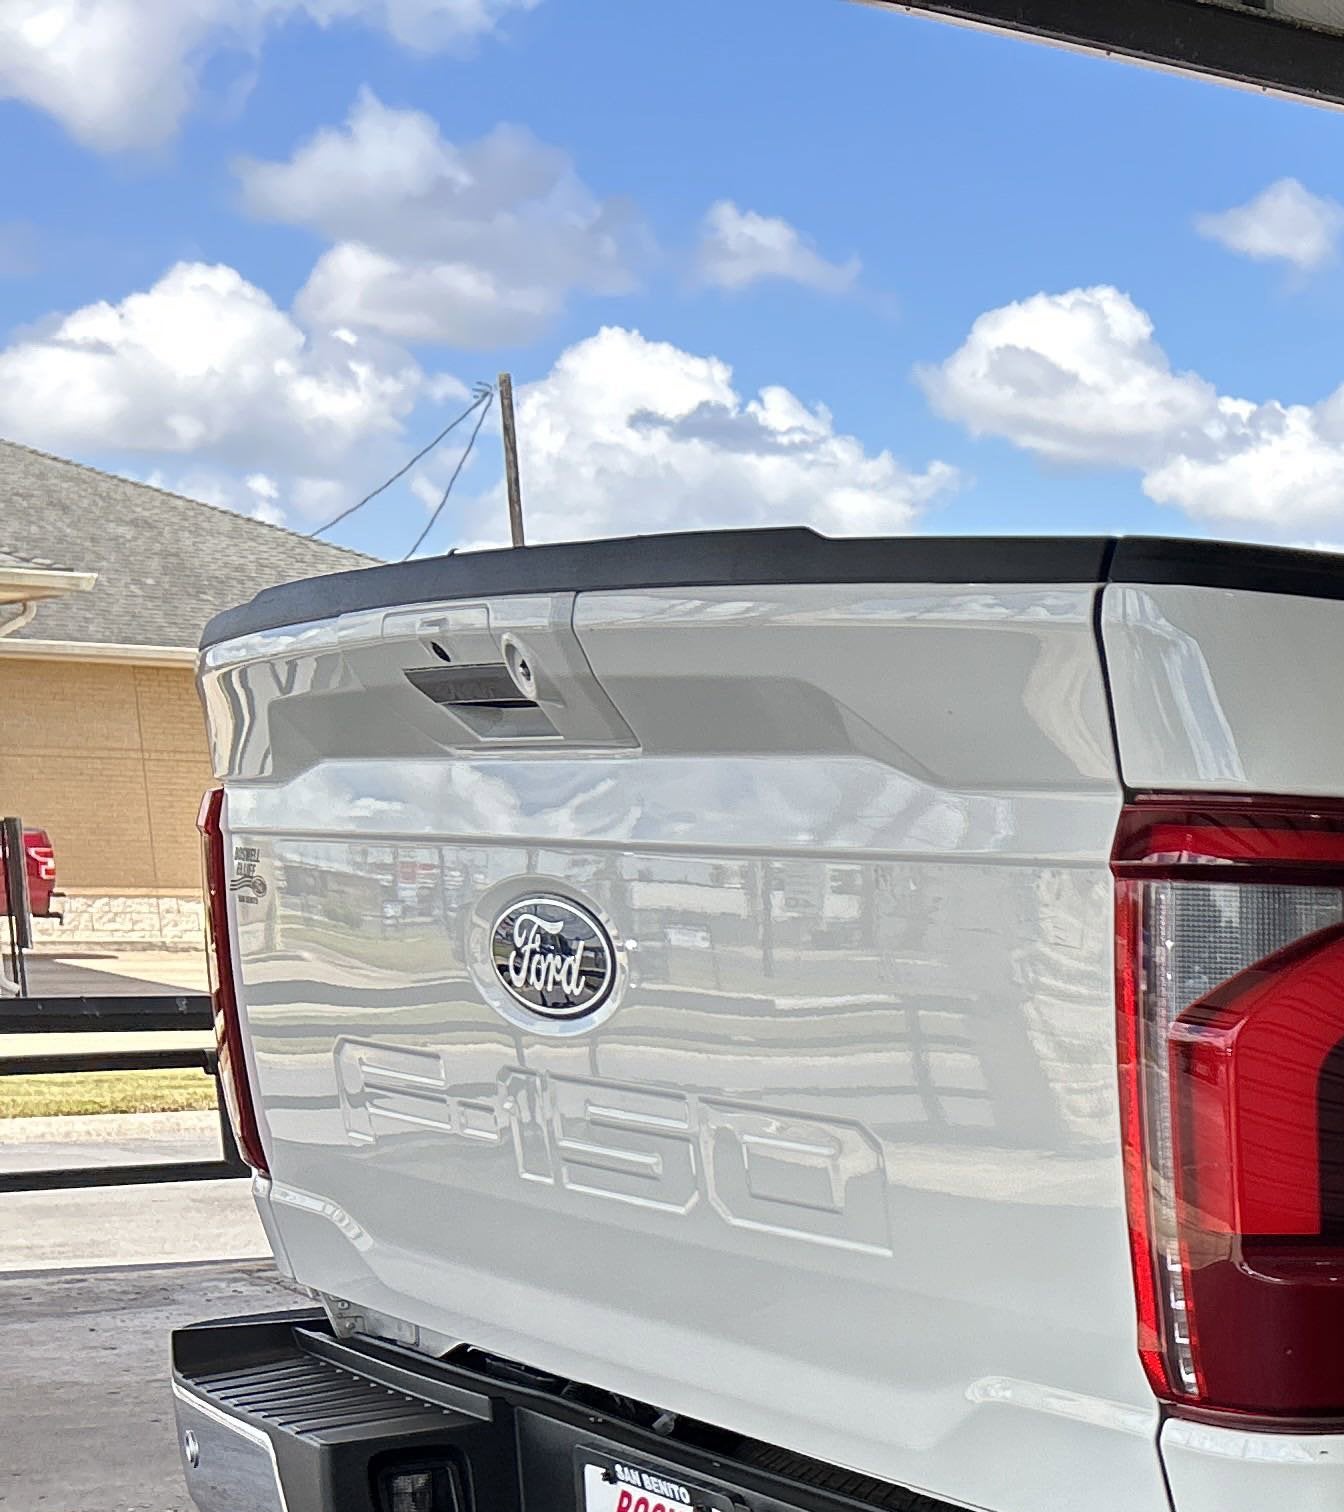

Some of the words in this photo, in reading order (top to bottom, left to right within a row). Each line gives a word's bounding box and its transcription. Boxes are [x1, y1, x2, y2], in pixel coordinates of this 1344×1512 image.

[508, 912, 587, 997] Ford
[614, 1463, 641, 1488] SAN
[642, 1472, 691, 1504] BENITO
